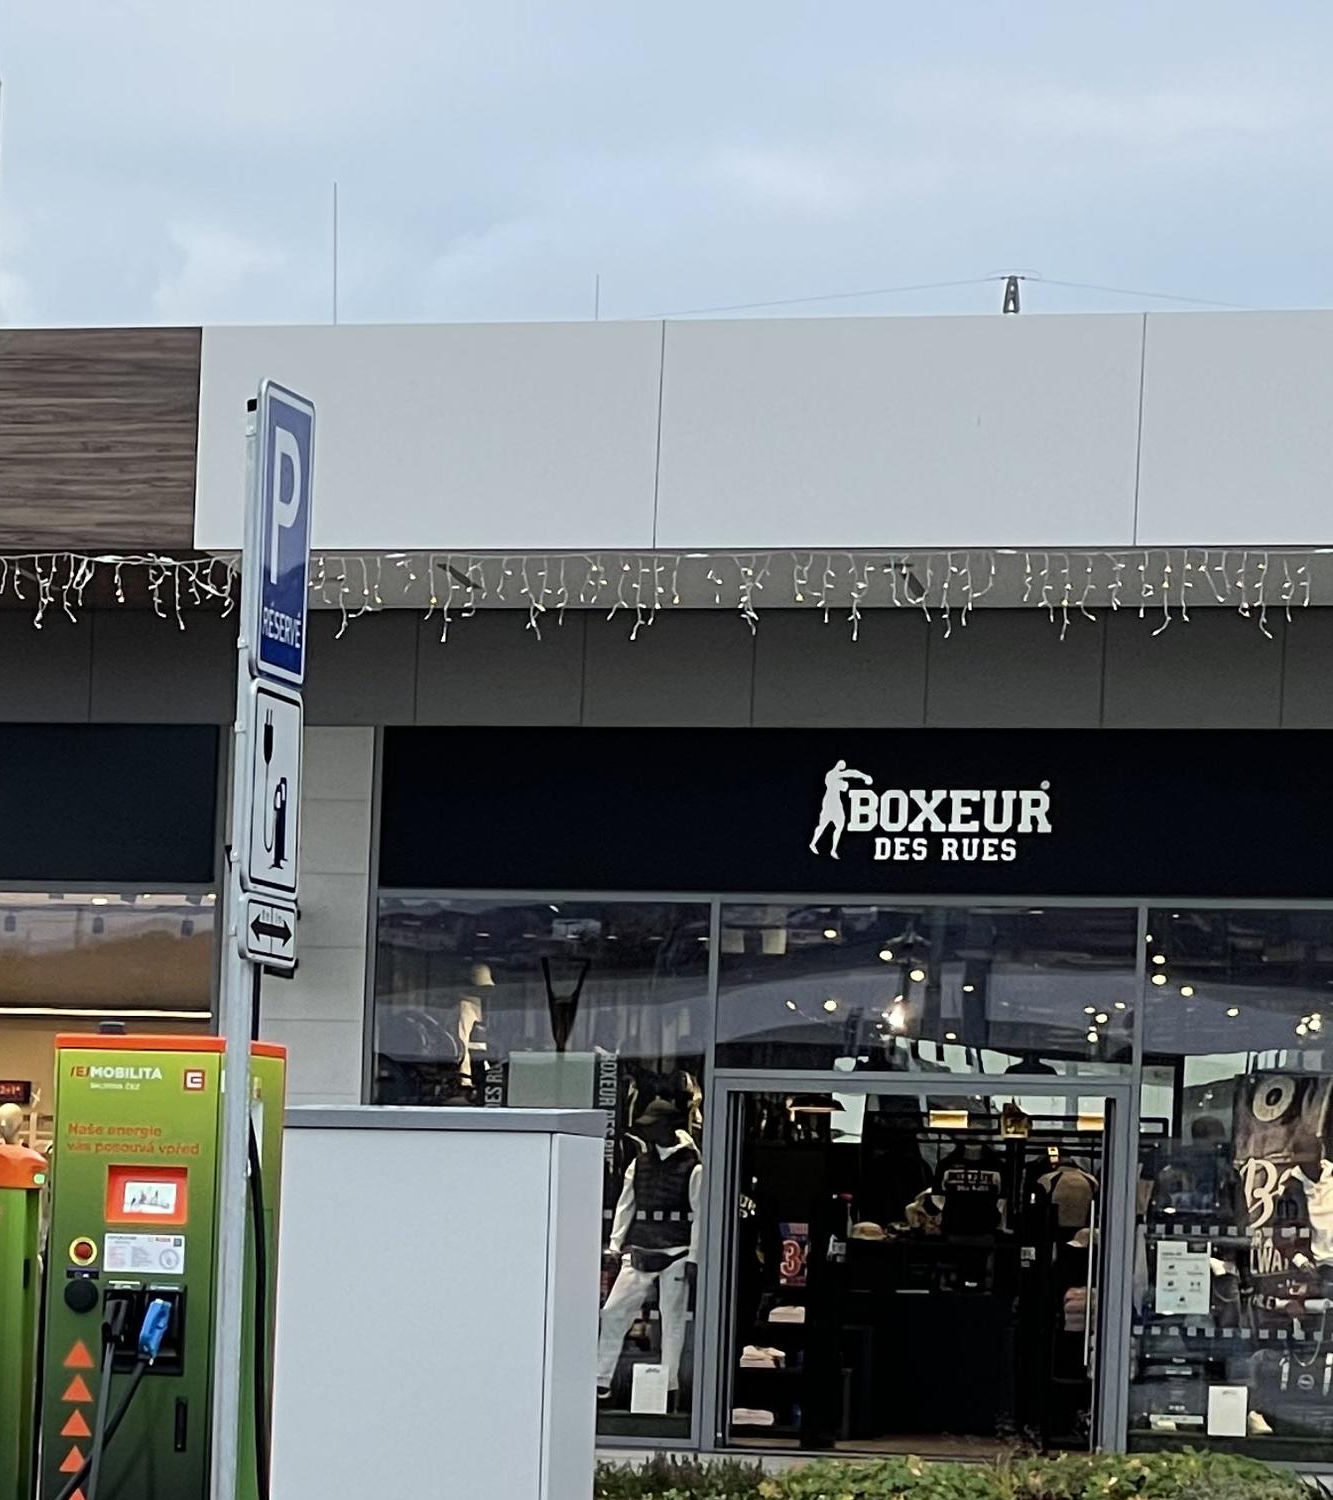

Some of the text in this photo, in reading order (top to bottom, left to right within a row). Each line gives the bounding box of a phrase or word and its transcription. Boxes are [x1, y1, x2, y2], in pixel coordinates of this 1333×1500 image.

[270, 426, 302, 585] P
[263, 601, 301, 648] RÉSERVÉ
[847, 789, 1052, 833] BOXEUR
[874, 837, 1017, 861] DES RUES
